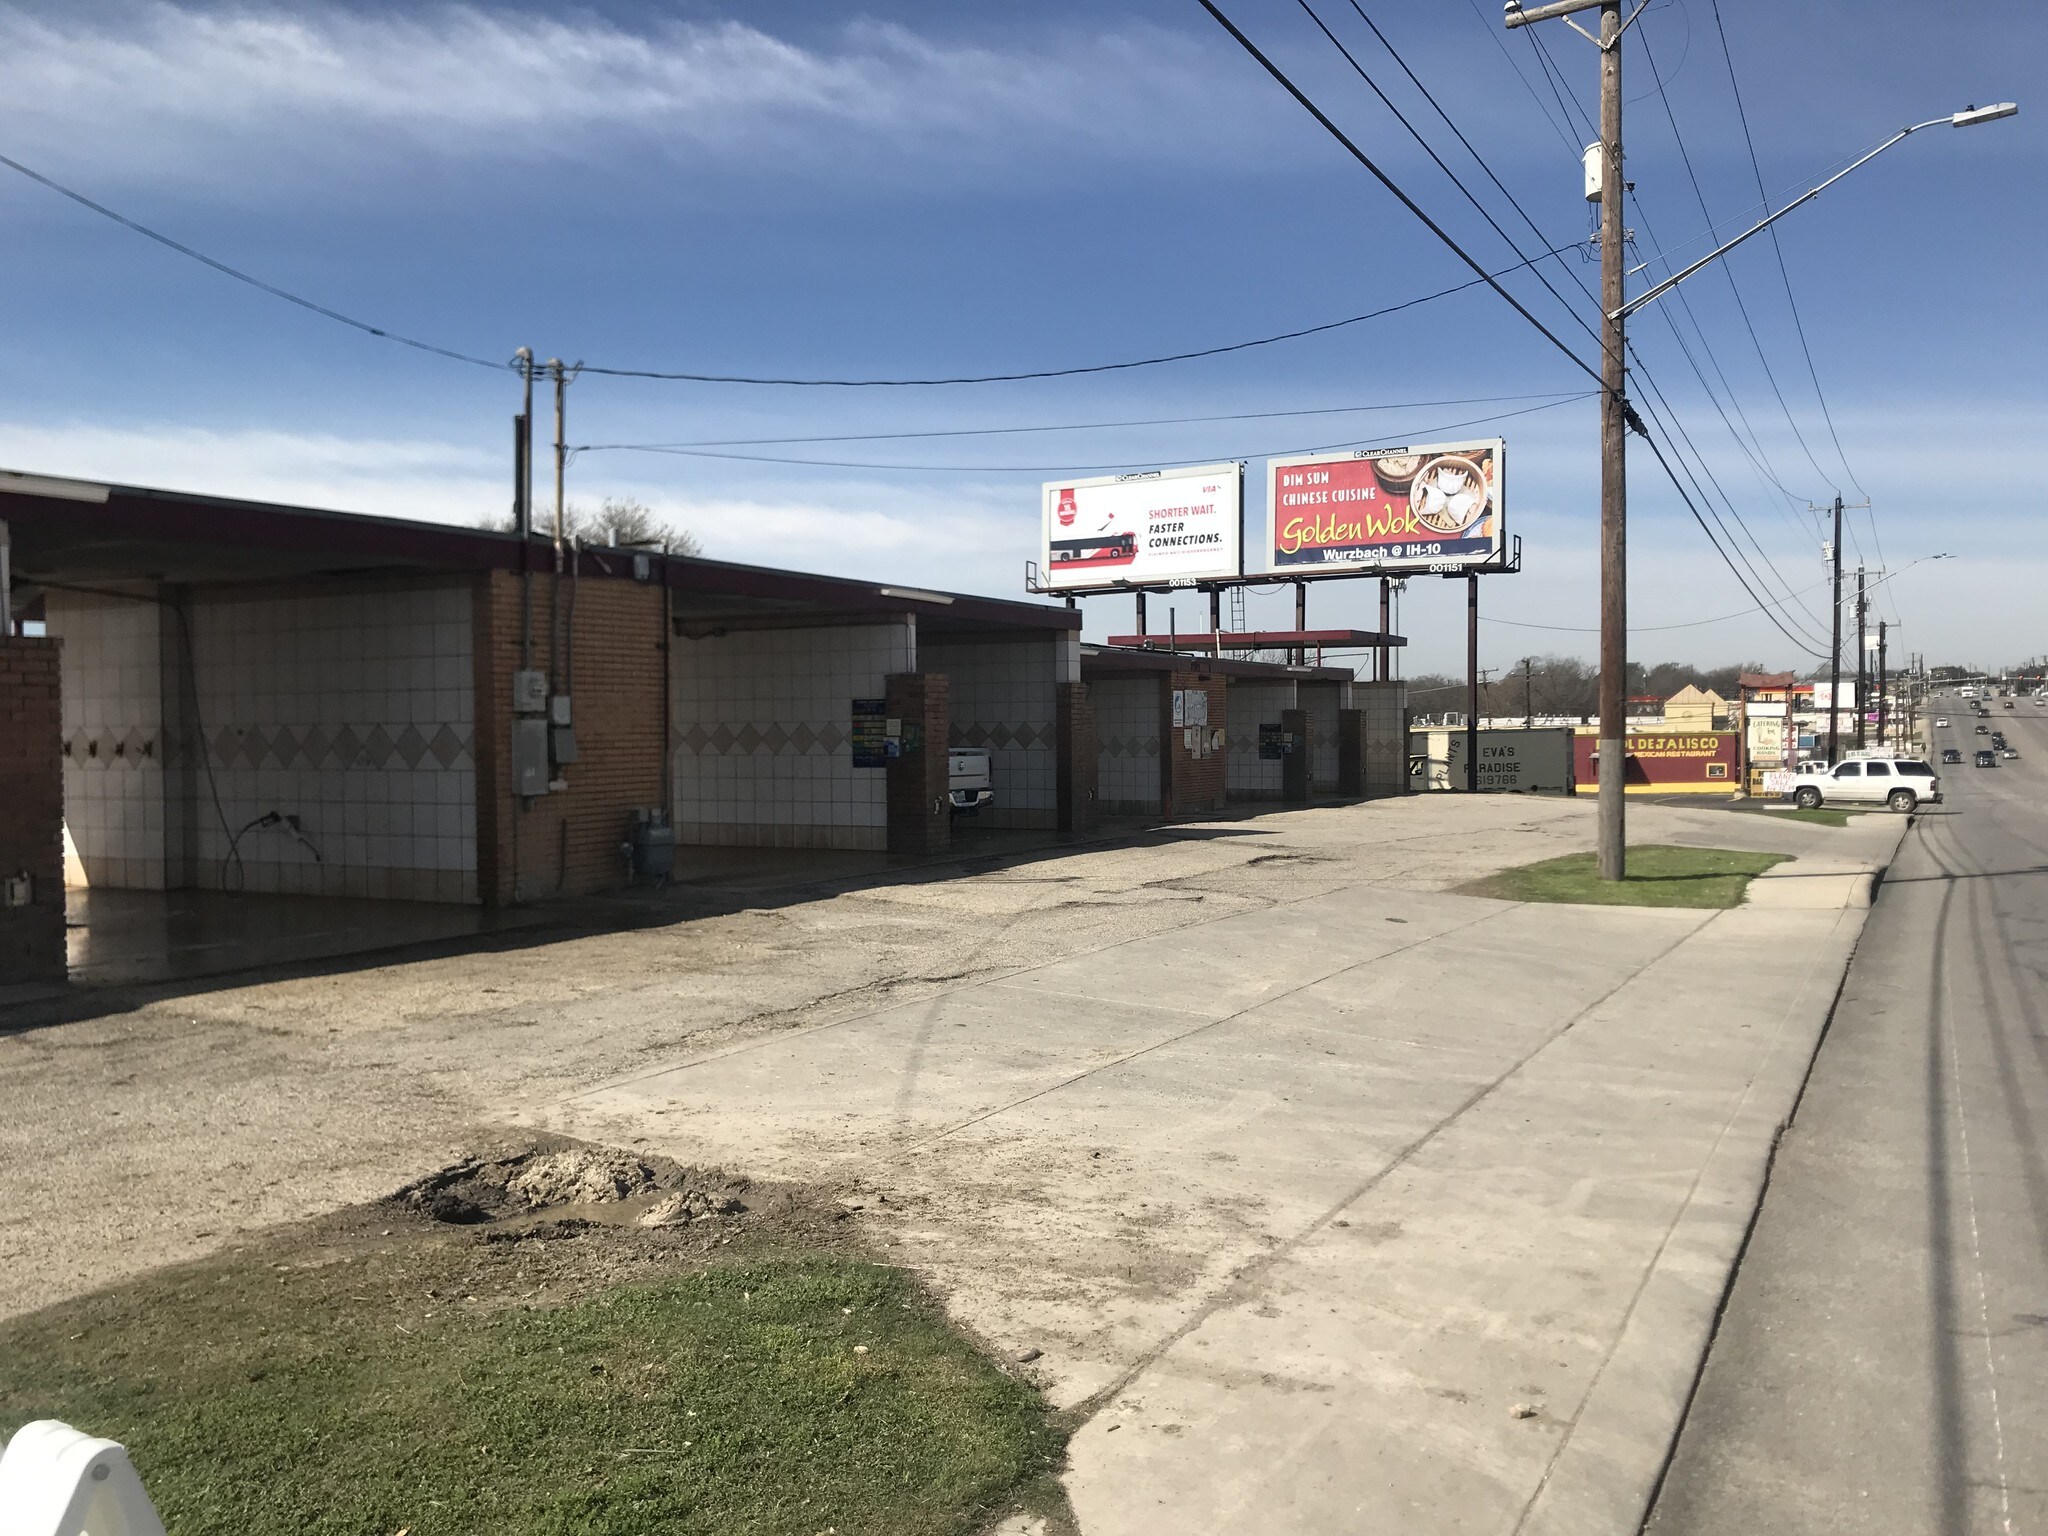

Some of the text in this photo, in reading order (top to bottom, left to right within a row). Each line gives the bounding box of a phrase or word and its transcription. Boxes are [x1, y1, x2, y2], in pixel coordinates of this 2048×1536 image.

[1283, 471, 1329, 487] DIM SUM
[1283, 487, 1376, 506] CHINESE CUISINE
[1149, 504, 1217, 520] SHORTER WAIT.
[1149, 522, 1184, 534] FASTER
[1280, 503, 1420, 554] Golden Wok
[1149, 533, 1223, 548] CONNECTIONS.
[1323, 543, 1441, 560] Wurzbach @ IH-10
[1429, 563, 1463, 572] 001151
[1169, 578, 1197, 587] 001153
[1753, 720, 1780, 728] CATERING
[1638, 738, 1655, 749] DE
[1655, 738, 1719, 750] JALISCO
[1482, 746, 1515, 757] EVA'S
[1435, 740, 1461, 781] PLANTS
[1464, 762, 1521, 773] PRADISE
